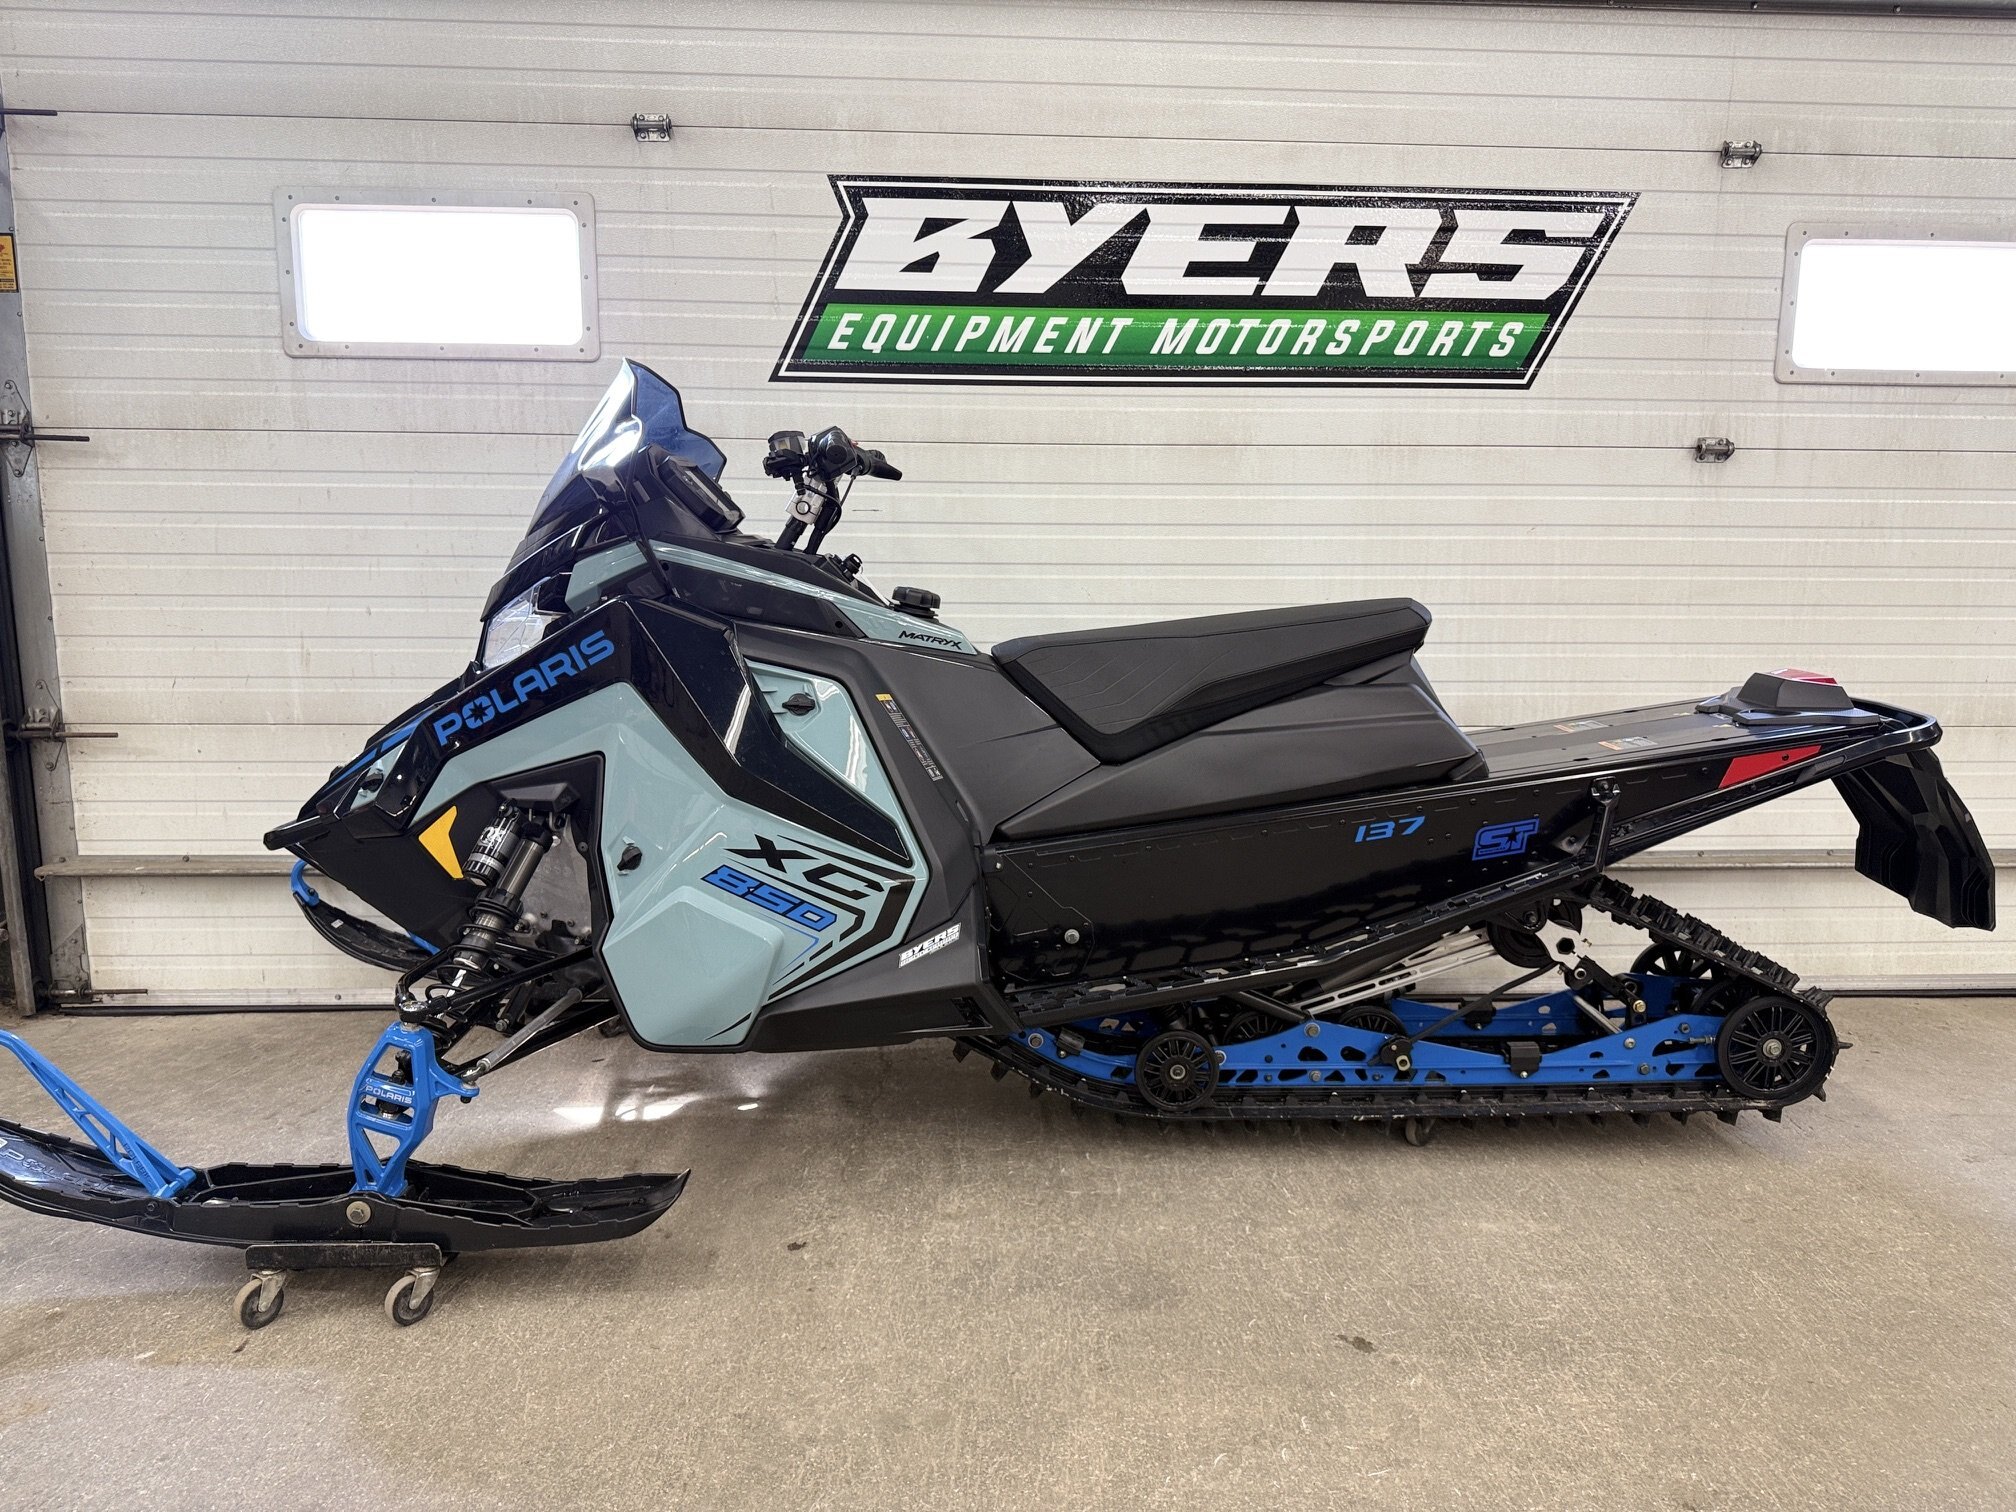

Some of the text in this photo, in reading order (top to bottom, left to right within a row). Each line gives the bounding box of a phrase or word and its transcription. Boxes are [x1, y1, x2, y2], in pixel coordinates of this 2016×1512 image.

[834, 197, 1605, 301] BYERS
[827, 312, 1525, 358] EQUIPMENT MOTORSPORTS
[898, 630, 963, 650] MATRYX
[434, 629, 616, 748] POLARIS
[1354, 815, 1426, 843] 137
[722, 833, 885, 901] XC
[700, 864, 838, 932] 850
[900, 923, 960, 962] BYERS
[365, 1084, 413, 1104] POLARIS
